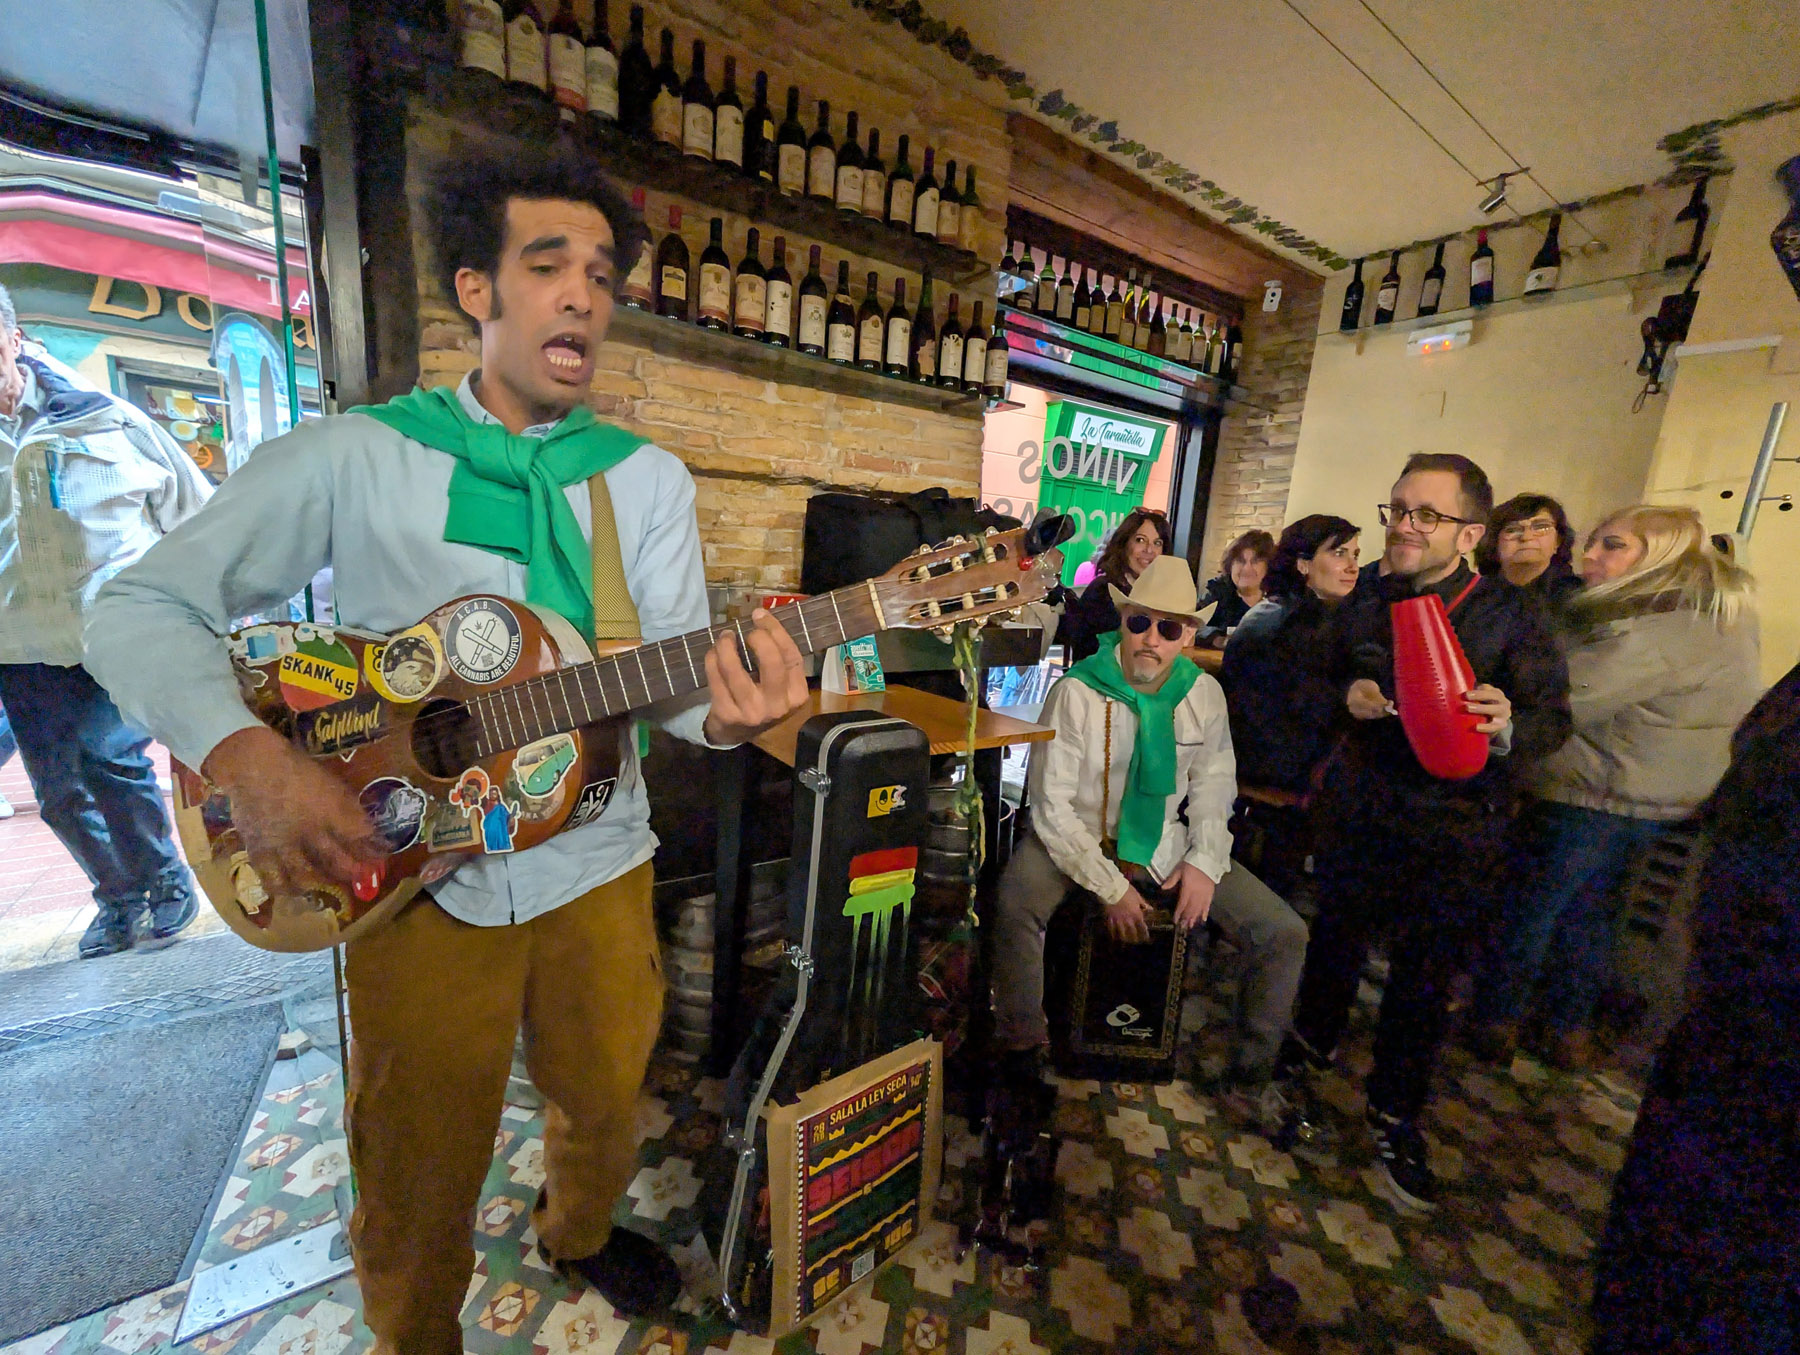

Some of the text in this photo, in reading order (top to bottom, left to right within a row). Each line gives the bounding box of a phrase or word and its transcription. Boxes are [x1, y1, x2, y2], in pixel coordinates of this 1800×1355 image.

[1080, 416, 1146, 448] La Tarantella
[282, 655, 355, 696] SKANK 45
[450, 633, 521, 682] ALL CANNABIS ARE BEAUTIFUL
[829, 1107, 854, 1126] SALA
[855, 1099, 868, 1114] LA
[868, 1087, 885, 1106] LEY
[886, 1073, 908, 1094] SECA
[812, 1122, 826, 1136] 28
